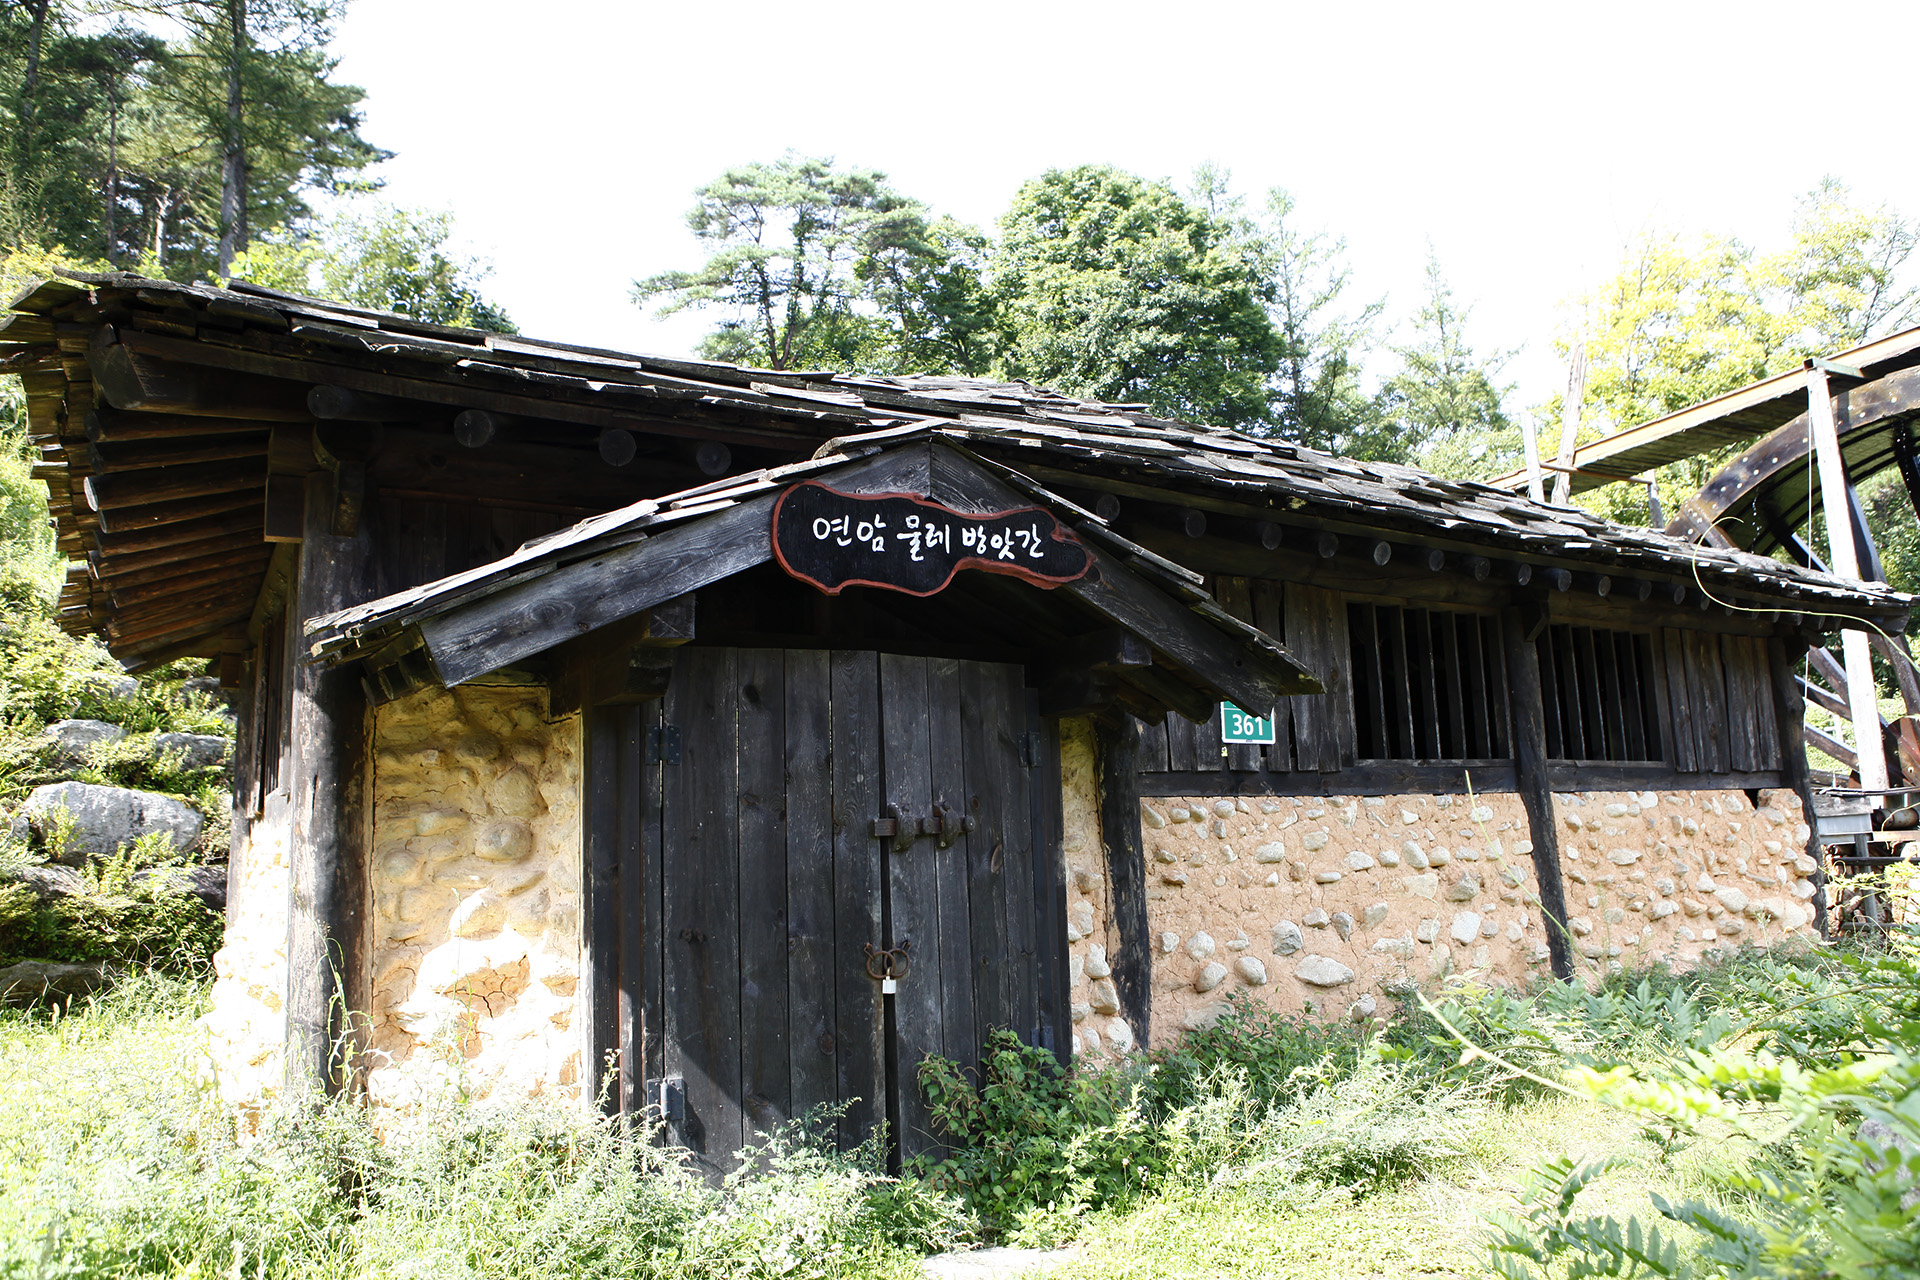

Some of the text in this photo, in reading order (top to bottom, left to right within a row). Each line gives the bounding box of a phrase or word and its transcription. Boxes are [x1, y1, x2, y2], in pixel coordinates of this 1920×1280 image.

[812, 513, 1045, 562] 연암 물레 방앗간
[1232, 713, 1264, 736] 361
